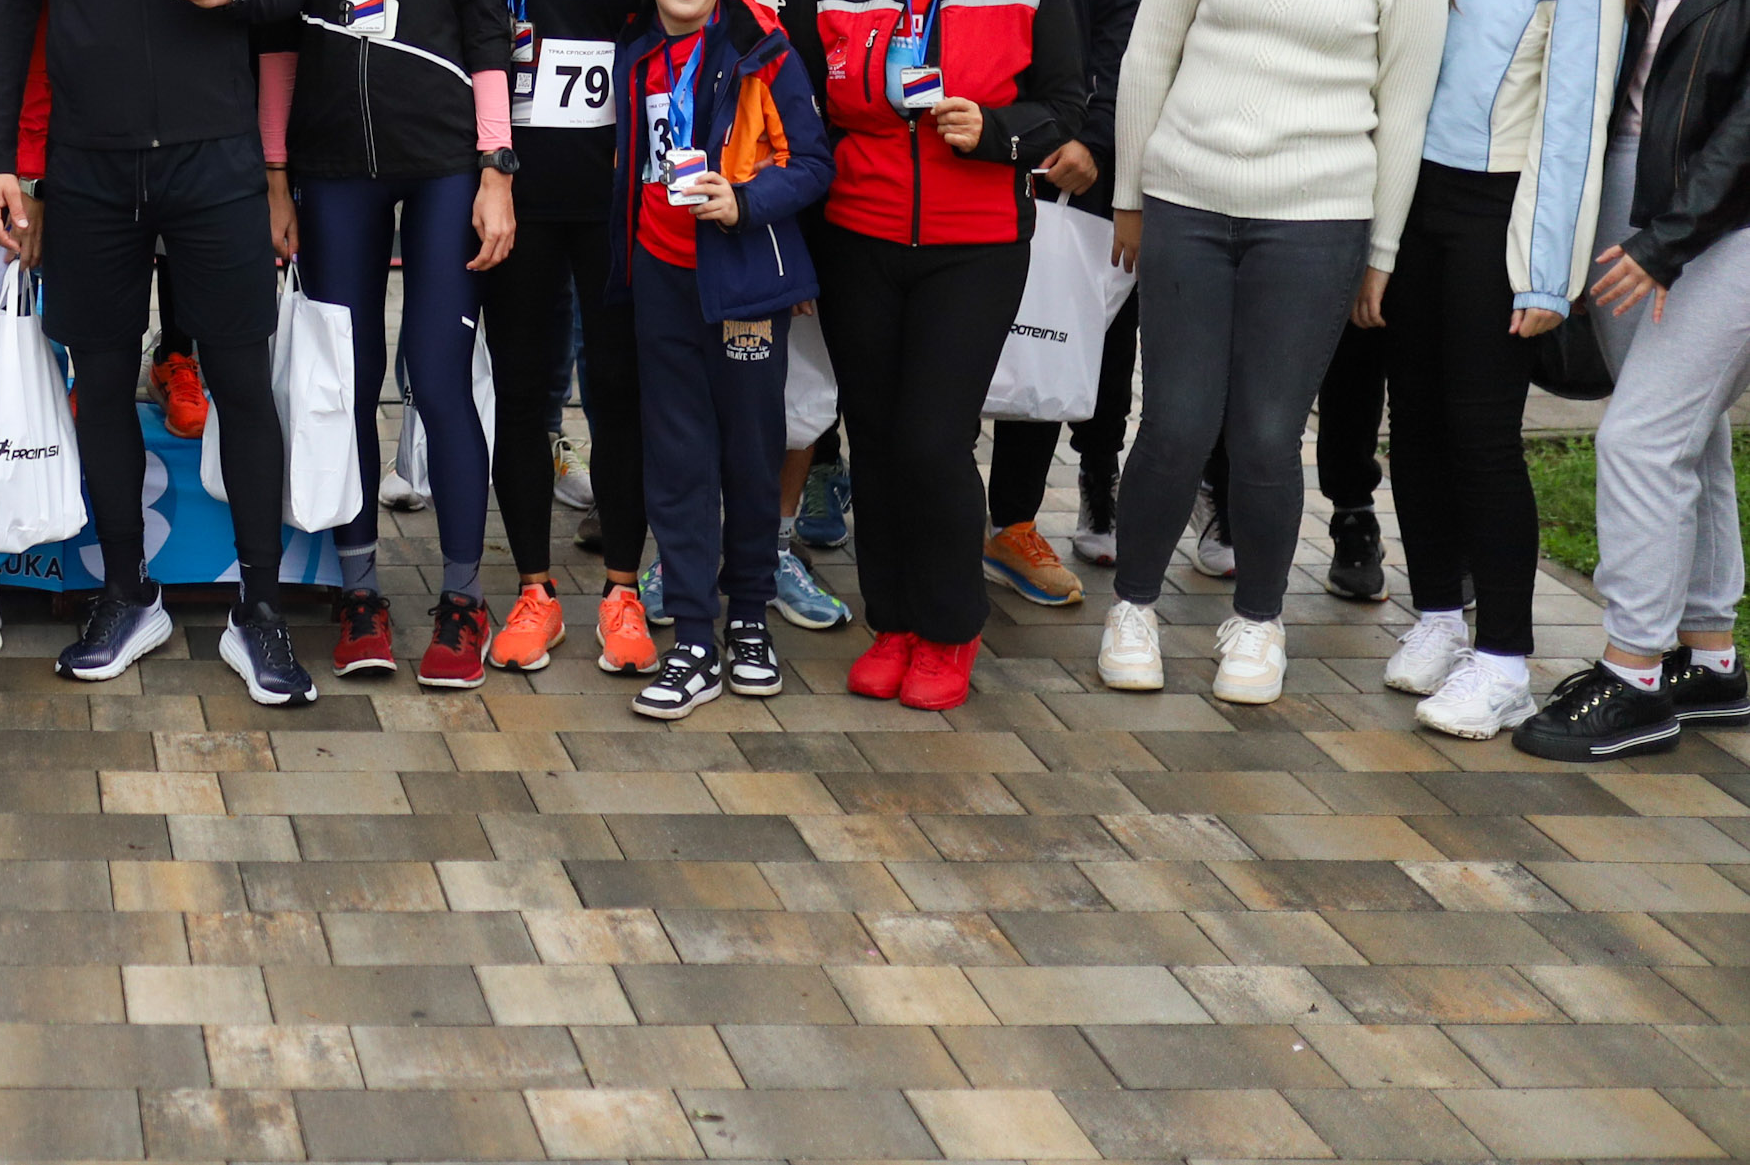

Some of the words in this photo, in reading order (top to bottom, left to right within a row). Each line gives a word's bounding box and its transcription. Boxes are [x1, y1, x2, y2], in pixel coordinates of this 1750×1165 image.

[555, 65, 610, 109] 79
[725, 349, 749, 361] BRAVE
[750, 350, 771, 361] CREW
